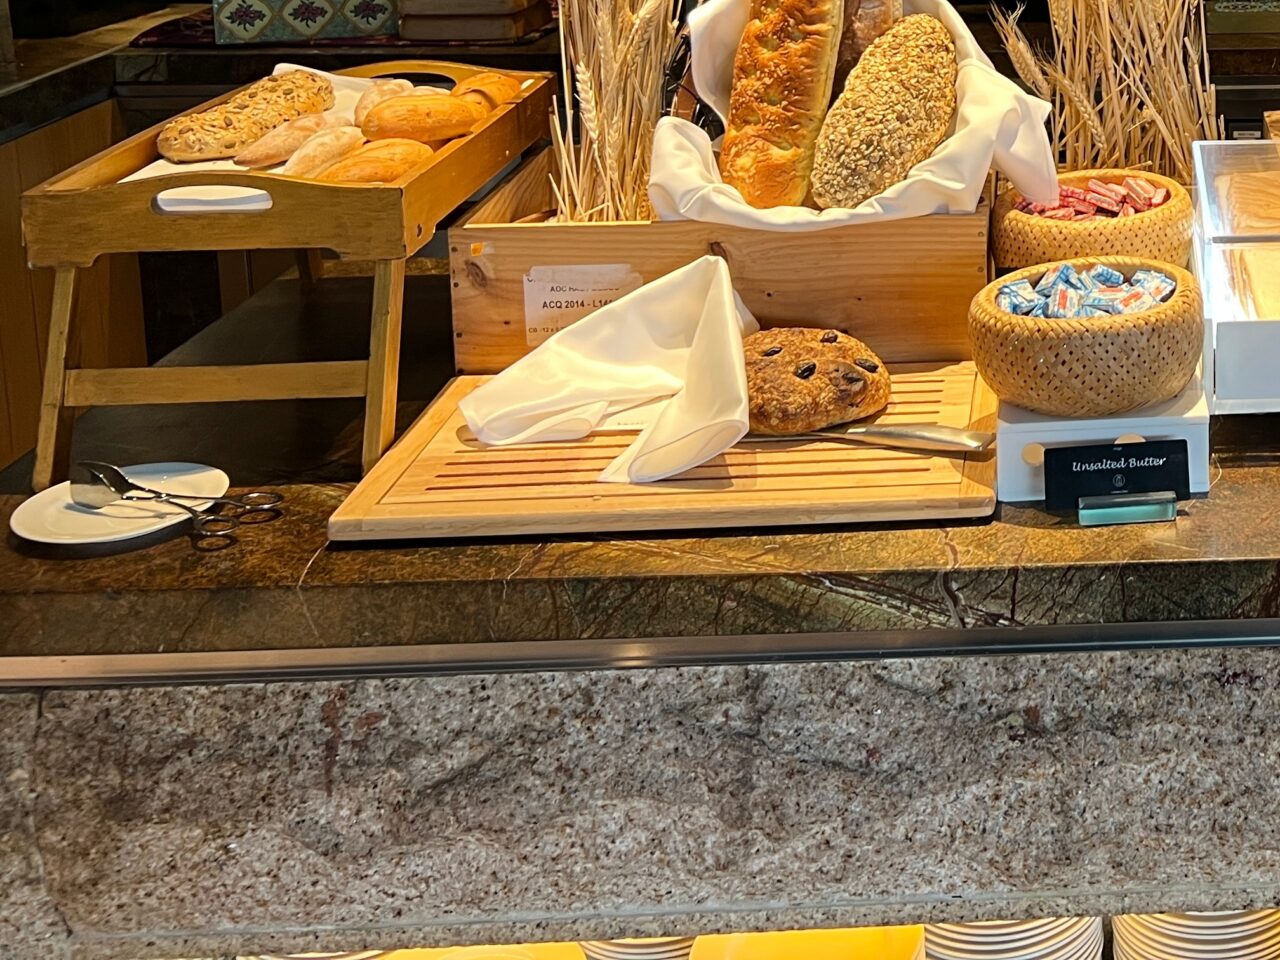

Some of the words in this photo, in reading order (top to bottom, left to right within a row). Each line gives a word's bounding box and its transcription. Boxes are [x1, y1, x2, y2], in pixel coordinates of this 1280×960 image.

[542, 300, 563, 309] ACQ
[564, 300, 585, 308] 2014
[1072, 457, 1127, 472] Unsalted
[1128, 457, 1166, 468] Butter
